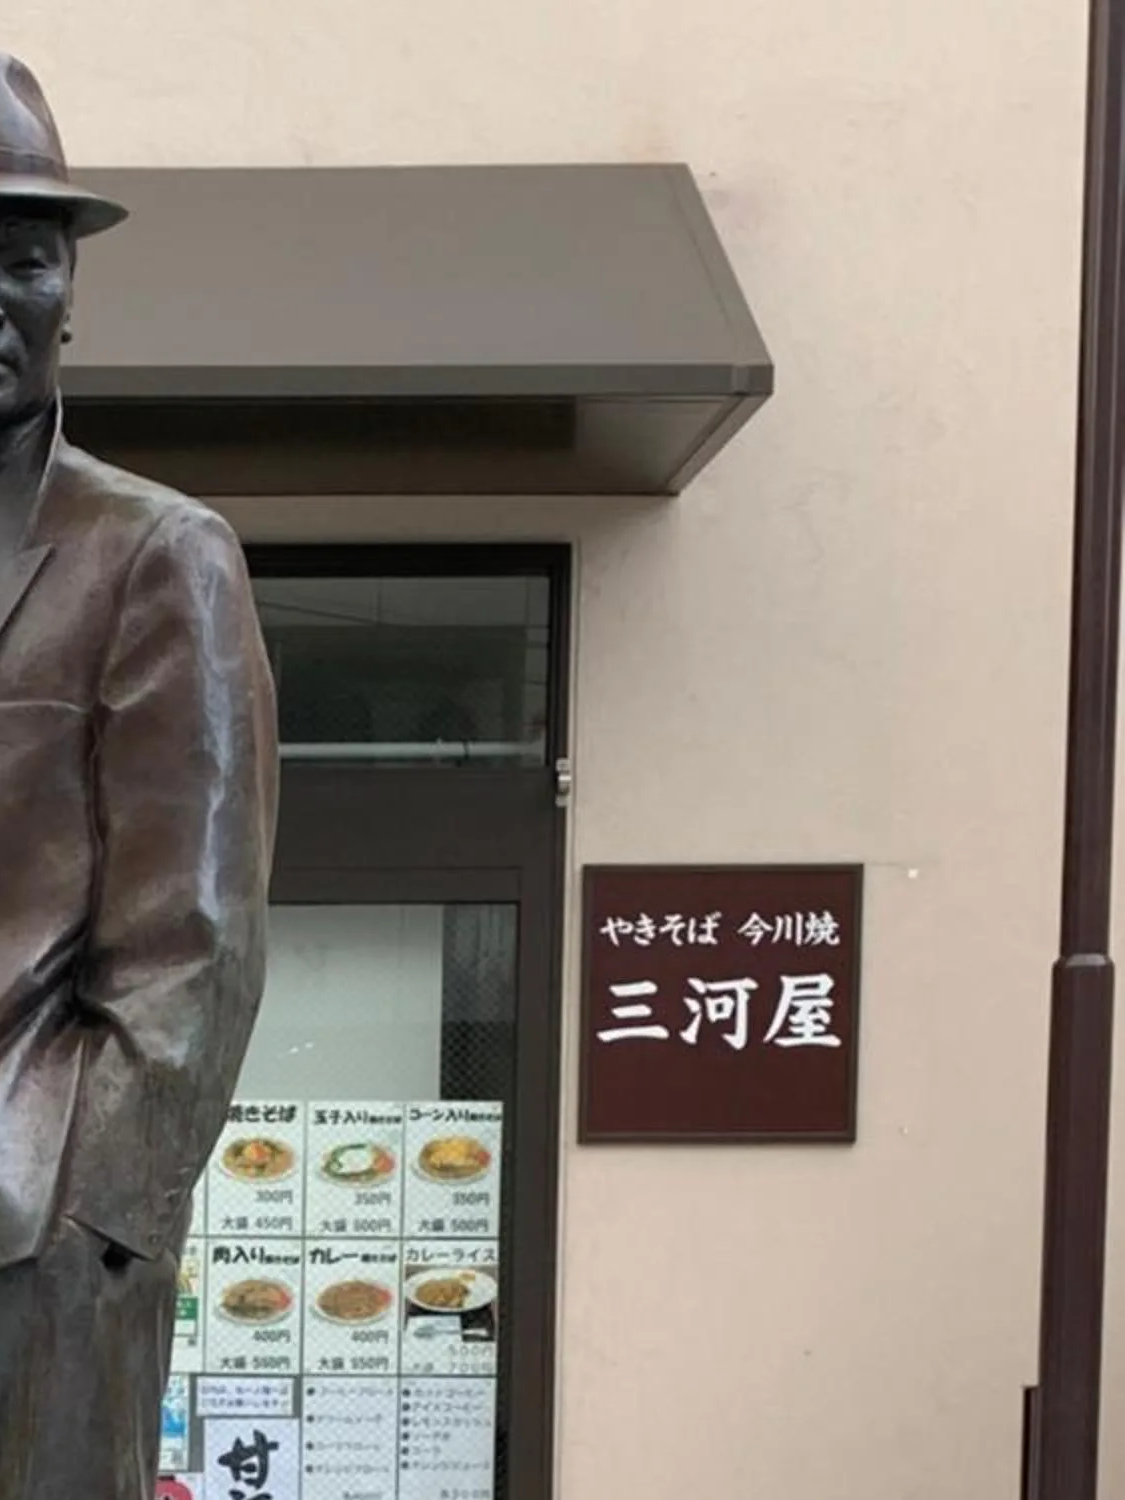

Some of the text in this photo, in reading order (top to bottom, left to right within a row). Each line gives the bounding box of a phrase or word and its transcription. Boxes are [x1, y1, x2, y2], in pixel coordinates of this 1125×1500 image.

[599, 910, 841, 947] やきそば 今川焼
[596, 973, 843, 1050] 三河屋
[406, 1246, 496, 1263] カレーライス
